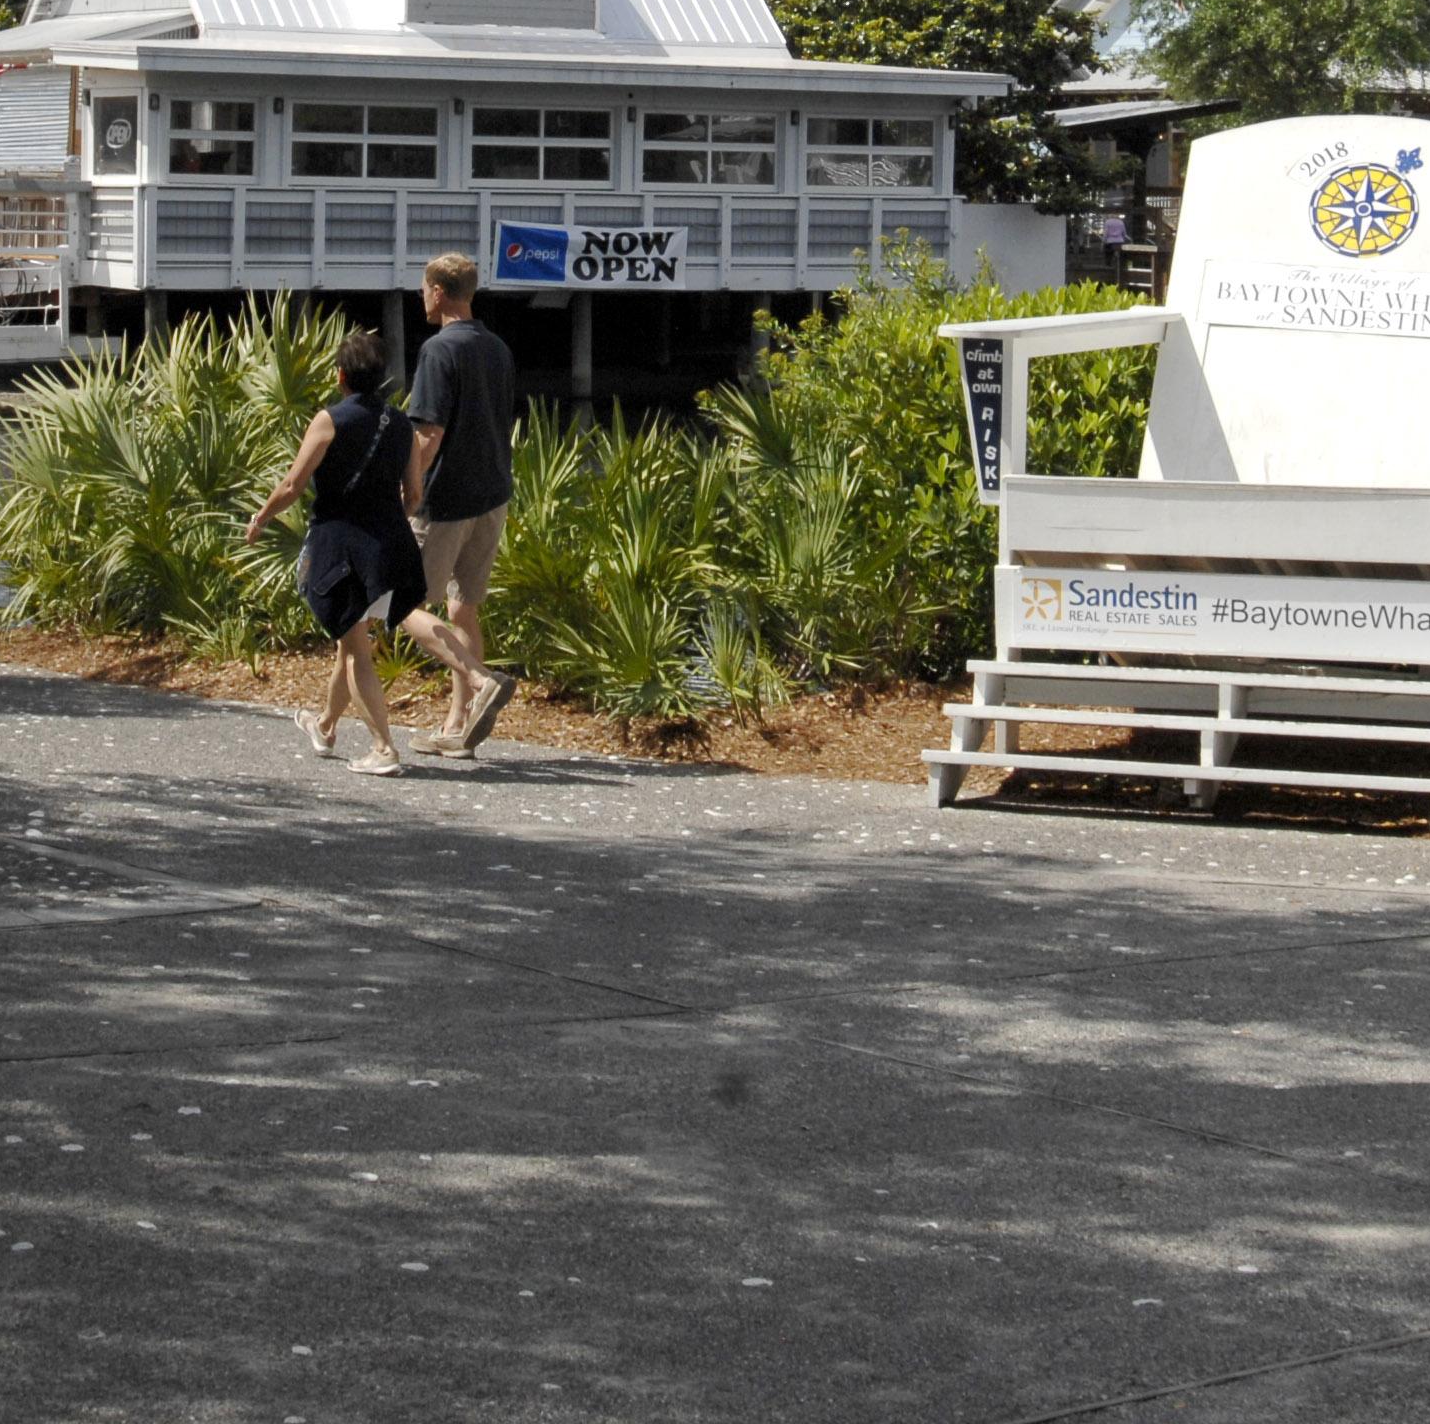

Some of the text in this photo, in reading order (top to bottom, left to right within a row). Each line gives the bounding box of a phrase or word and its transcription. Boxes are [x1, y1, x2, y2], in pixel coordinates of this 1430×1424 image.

[1299, 141, 1348, 177] 2018
[581, 231, 674, 256] NOW
[524, 248, 559, 261] pepsi
[572, 256, 678, 282] OPEN
[1288, 269, 1420, 290] The Village of
[1218, 281, 1374, 310] BAYTOWNE
[1256, 311, 1274, 322] at
[966, 349, 1003, 363] climb
[977, 368, 994, 380] at
[972, 383, 1001, 394] own
[981, 407, 997, 480] RISK
[1069, 580, 1197, 611] Sandestin
[1069, 610, 1197, 627] REAL ESTATE SALES
